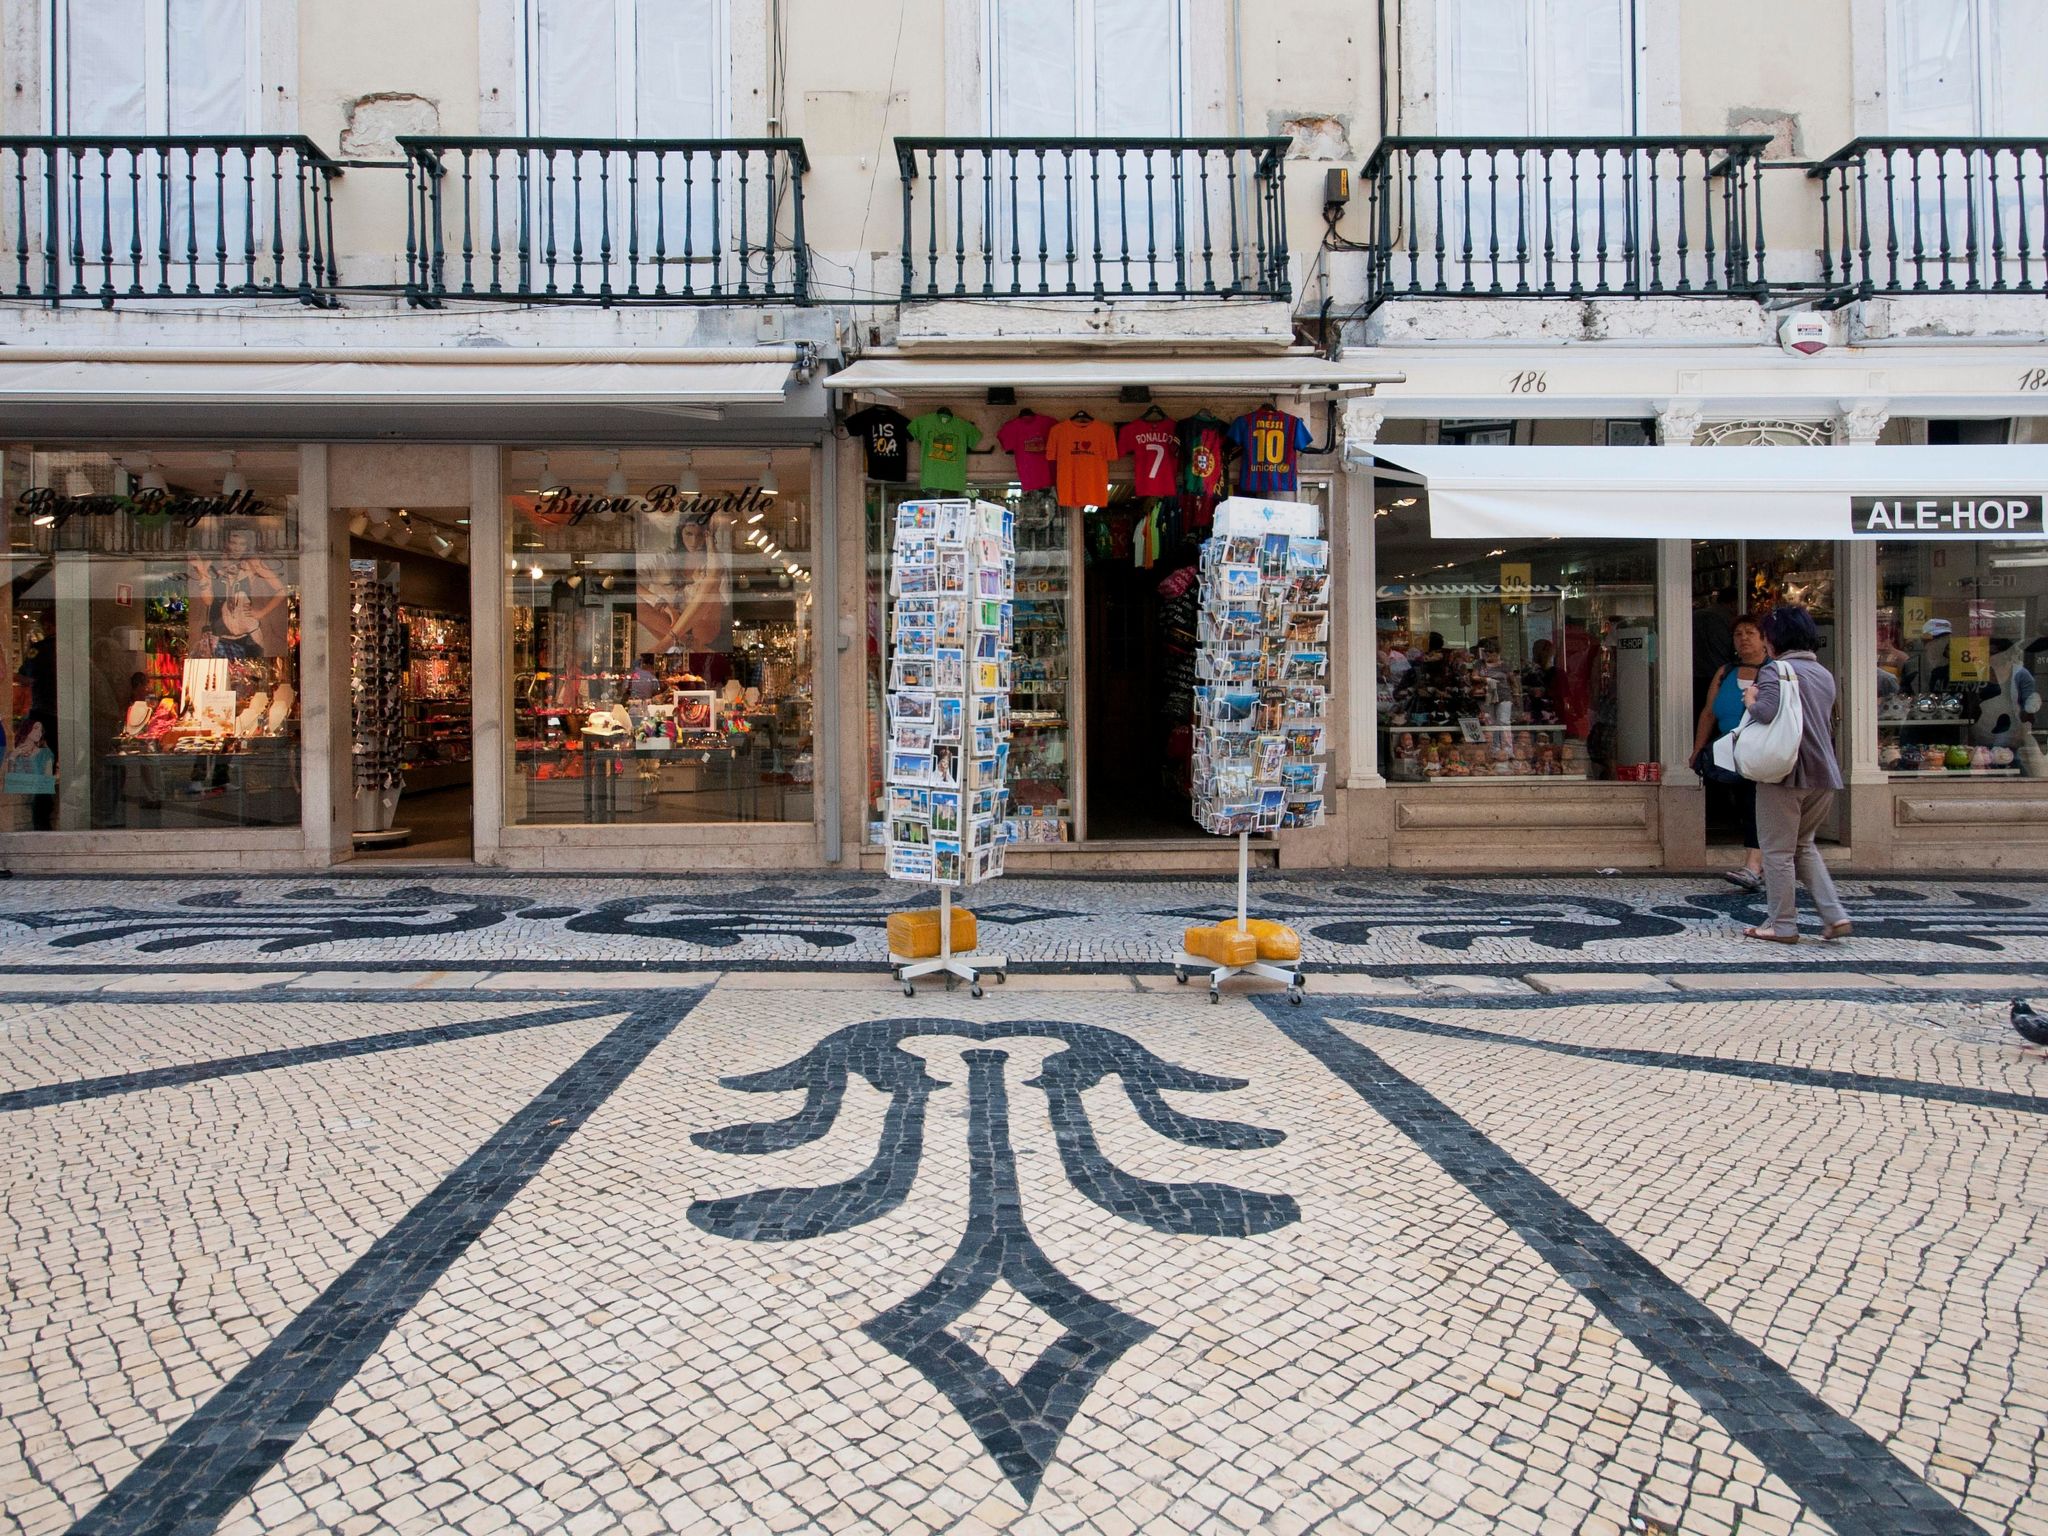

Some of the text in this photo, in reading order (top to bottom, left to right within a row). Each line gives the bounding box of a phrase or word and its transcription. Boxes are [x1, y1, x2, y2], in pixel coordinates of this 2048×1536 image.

[1509, 371, 1546, 392] 186
[1256, 420, 1284, 429] MESSI
[1145, 443, 1165, 479] 7
[1253, 429, 1285, 464] 10
[1250, 463, 1278, 472] unicef
[14, 487, 275, 529] Bijou Brigitte
[535, 483, 774, 526] Bijou Brigitte
[1866, 500, 2029, 529] ALE-HOP
